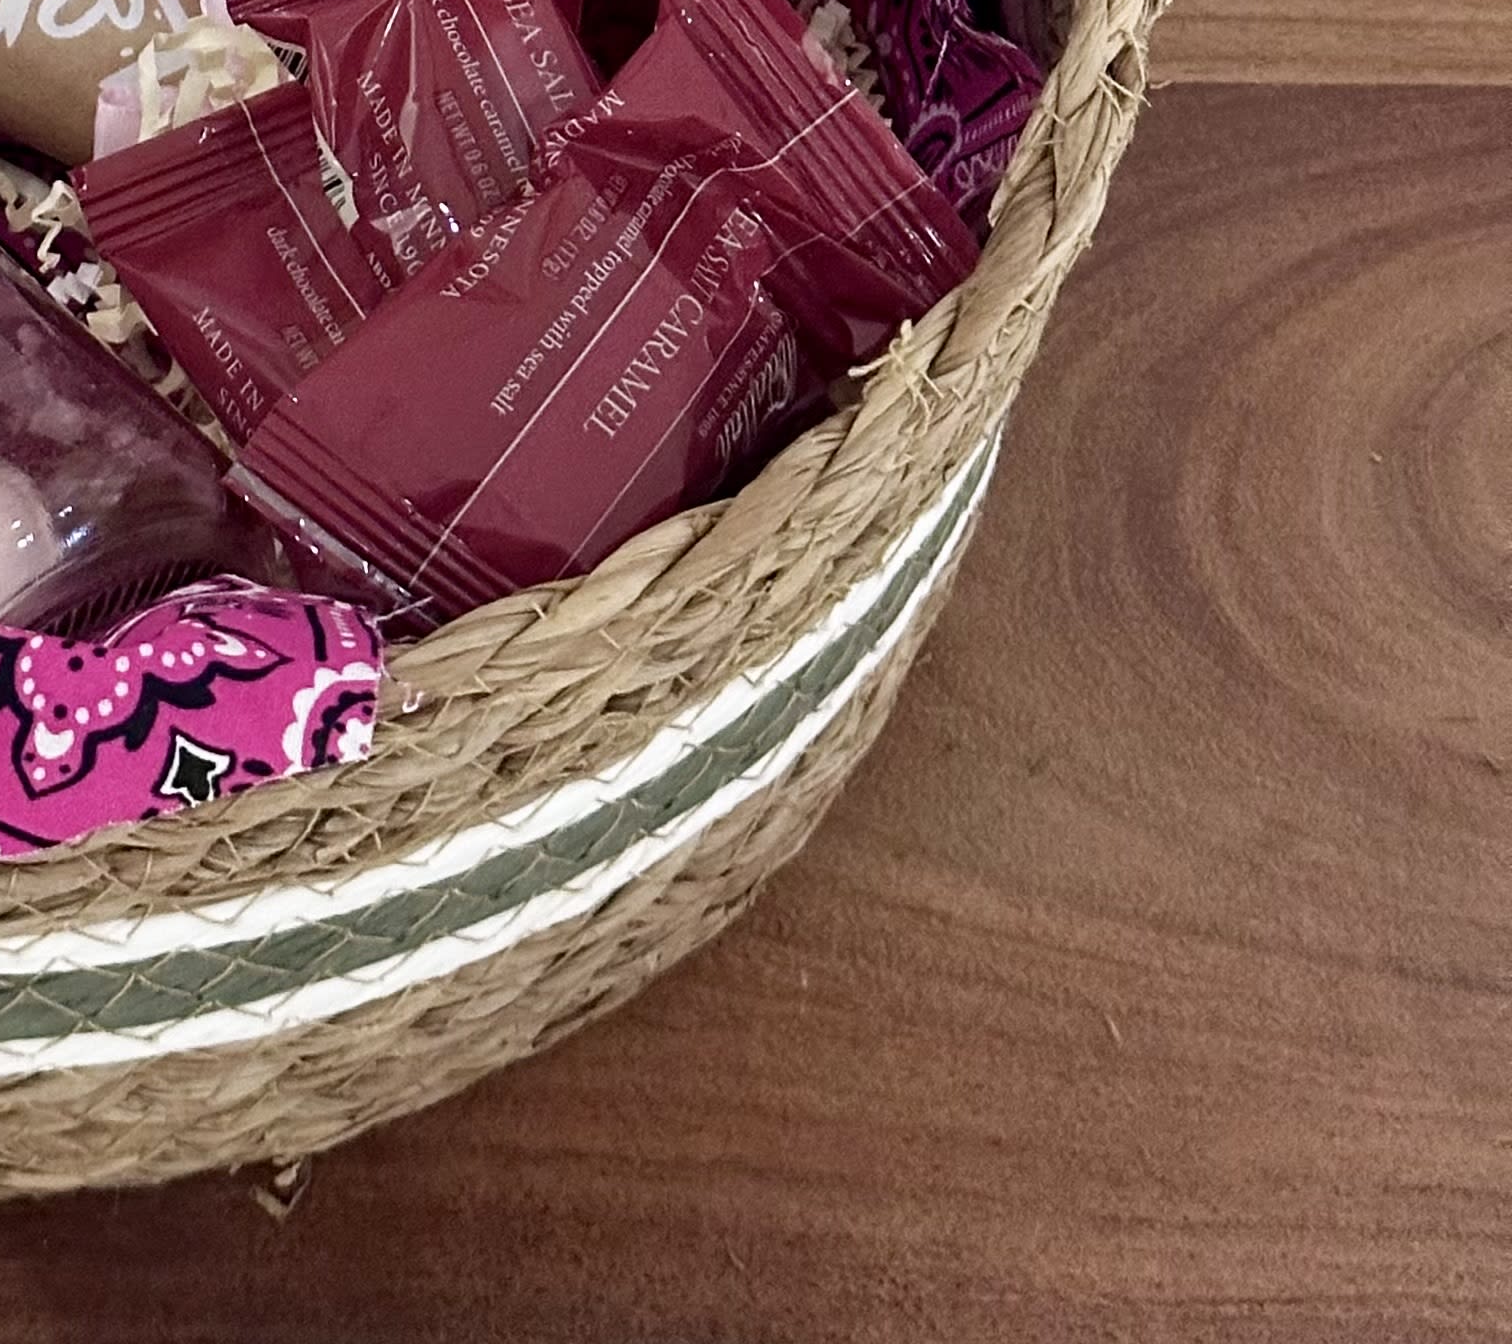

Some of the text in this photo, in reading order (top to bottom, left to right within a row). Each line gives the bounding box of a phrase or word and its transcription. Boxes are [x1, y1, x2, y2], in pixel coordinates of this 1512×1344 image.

[437, 7, 487, 96] chocolate
[481, 98, 529, 174] caramel
[530, 49, 577, 112] SAL
[357, 69, 399, 144] MADE
[391, 146, 413, 180] IN
[715, 207, 761, 252] EA
[569, 250, 625, 316] topped
[191, 306, 265, 412] MADE IN
[537, 309, 578, 353] with
[515, 347, 546, 381] sea
[583, 293, 705, 440] CARAMEL
[488, 377, 522, 417] salt
